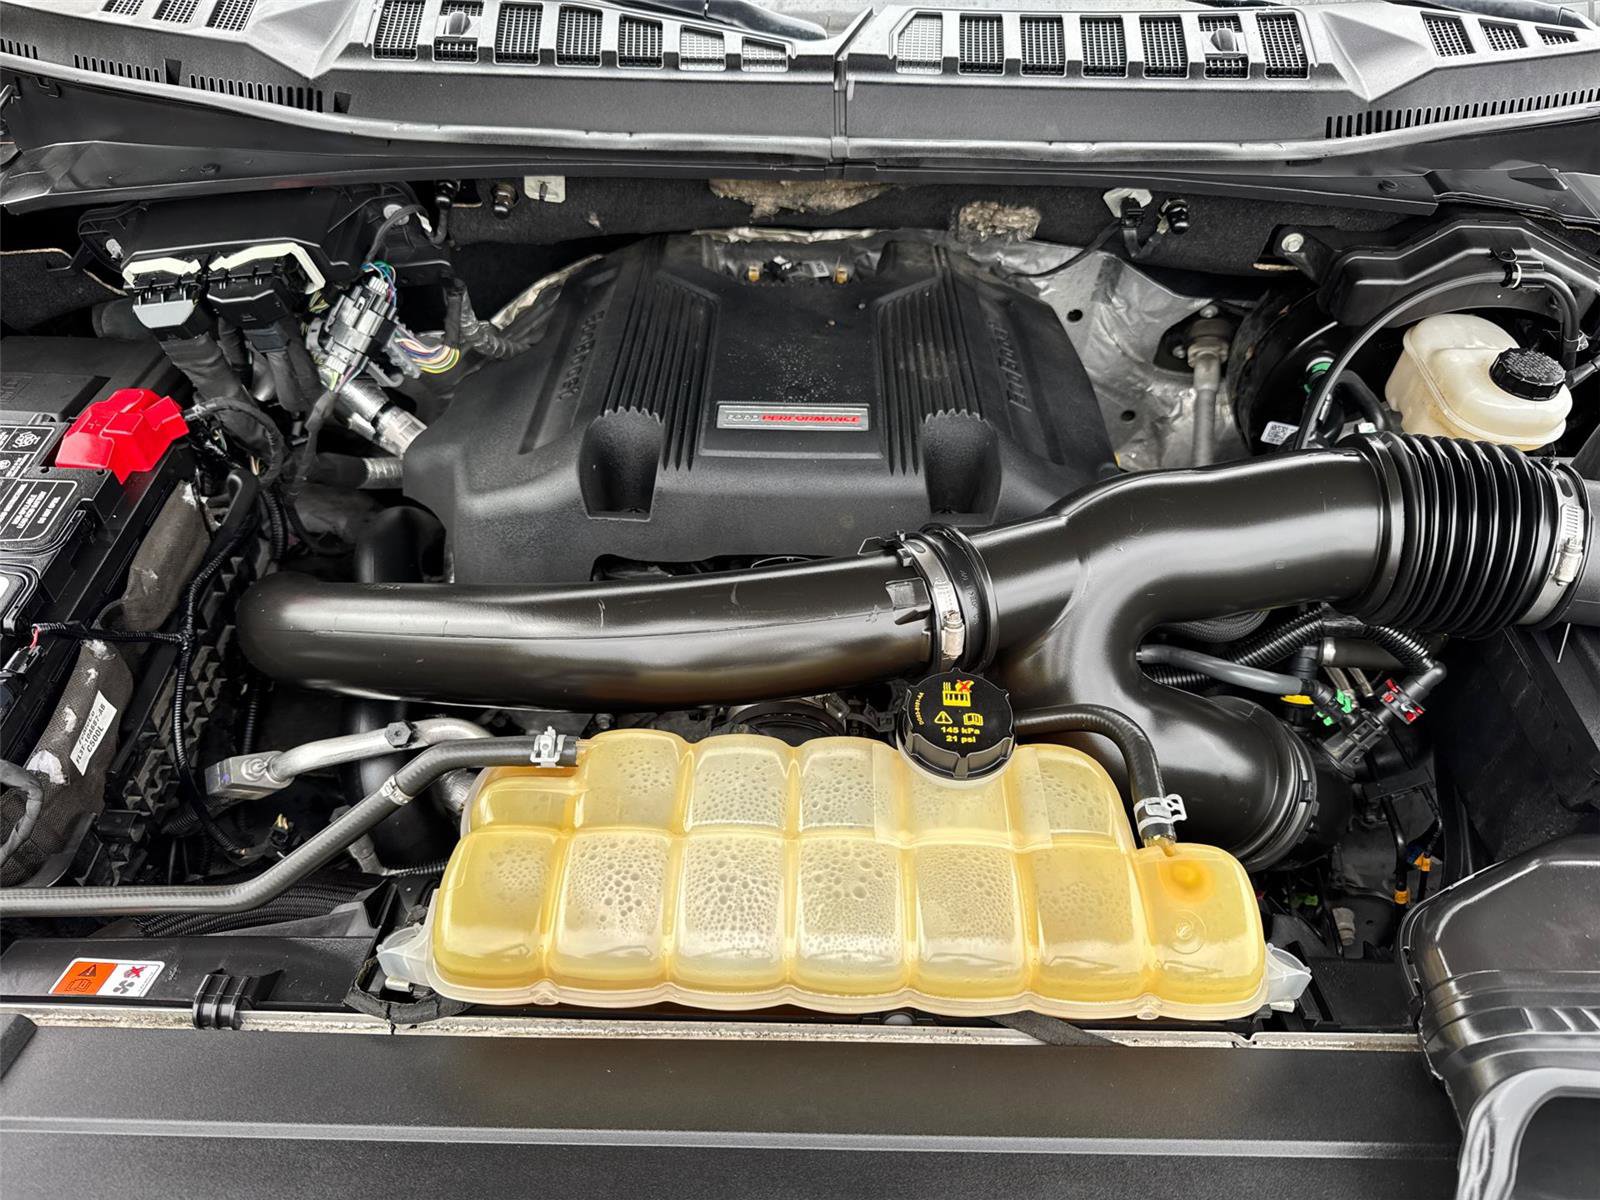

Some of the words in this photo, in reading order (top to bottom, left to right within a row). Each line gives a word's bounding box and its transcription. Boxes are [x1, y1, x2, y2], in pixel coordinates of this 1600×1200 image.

[761, 412, 860, 424] PERFORMANCE
[941, 726, 959, 734] 145
[961, 727, 980, 735] kPa
[961, 736, 976, 744] psi
